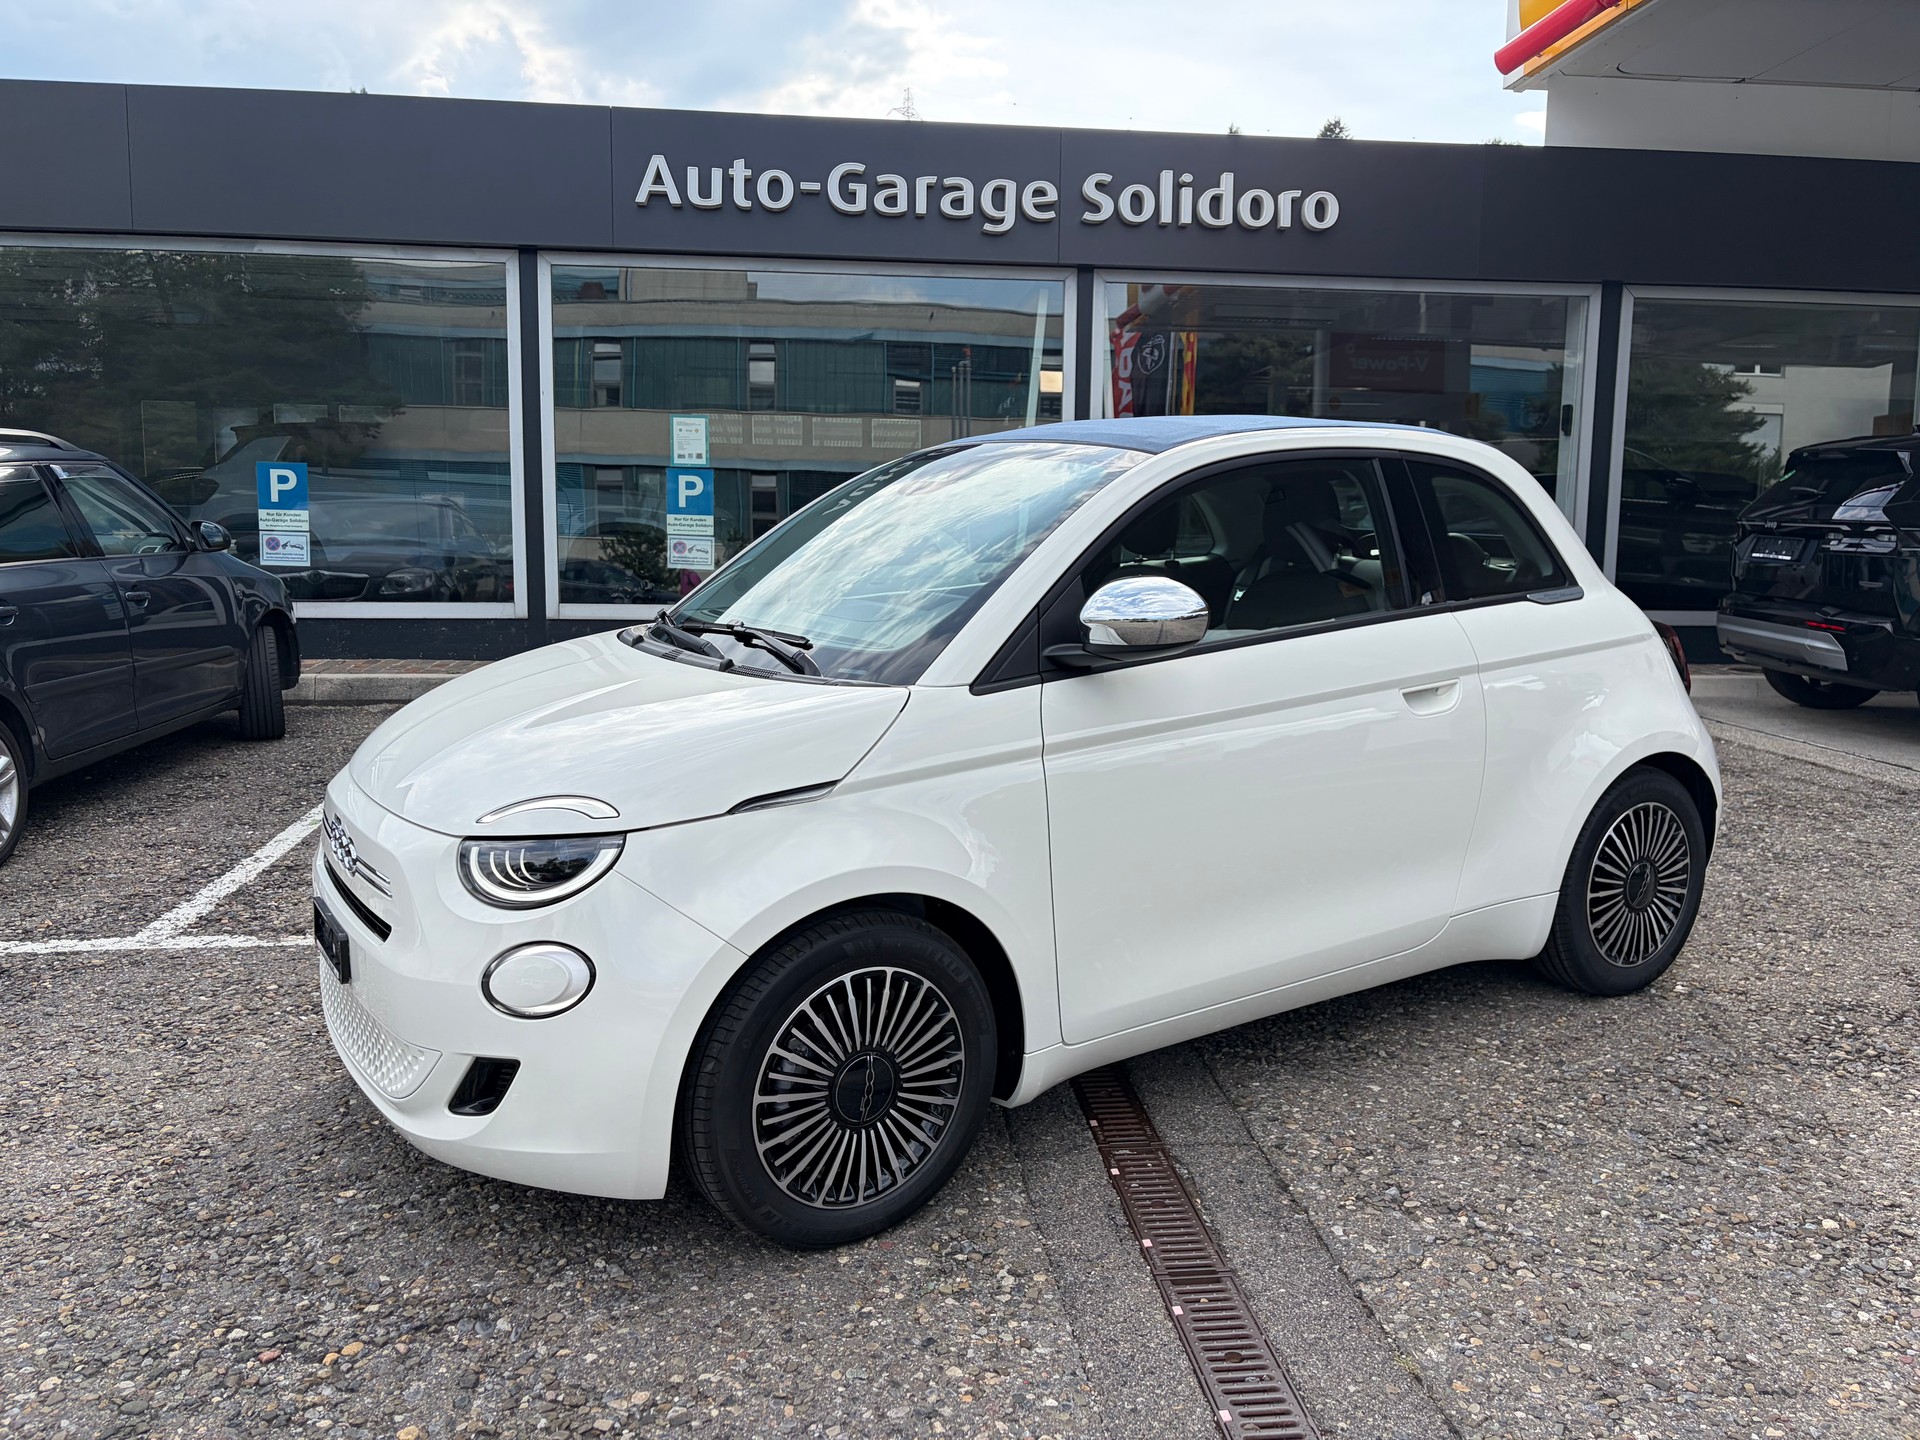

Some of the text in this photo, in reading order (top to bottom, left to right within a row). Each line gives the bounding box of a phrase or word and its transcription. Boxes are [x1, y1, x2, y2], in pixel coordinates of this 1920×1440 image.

[634, 153, 1341, 236] Auto-Garage Solidoro
[269, 468, 298, 503] P
[678, 474, 705, 508] P
